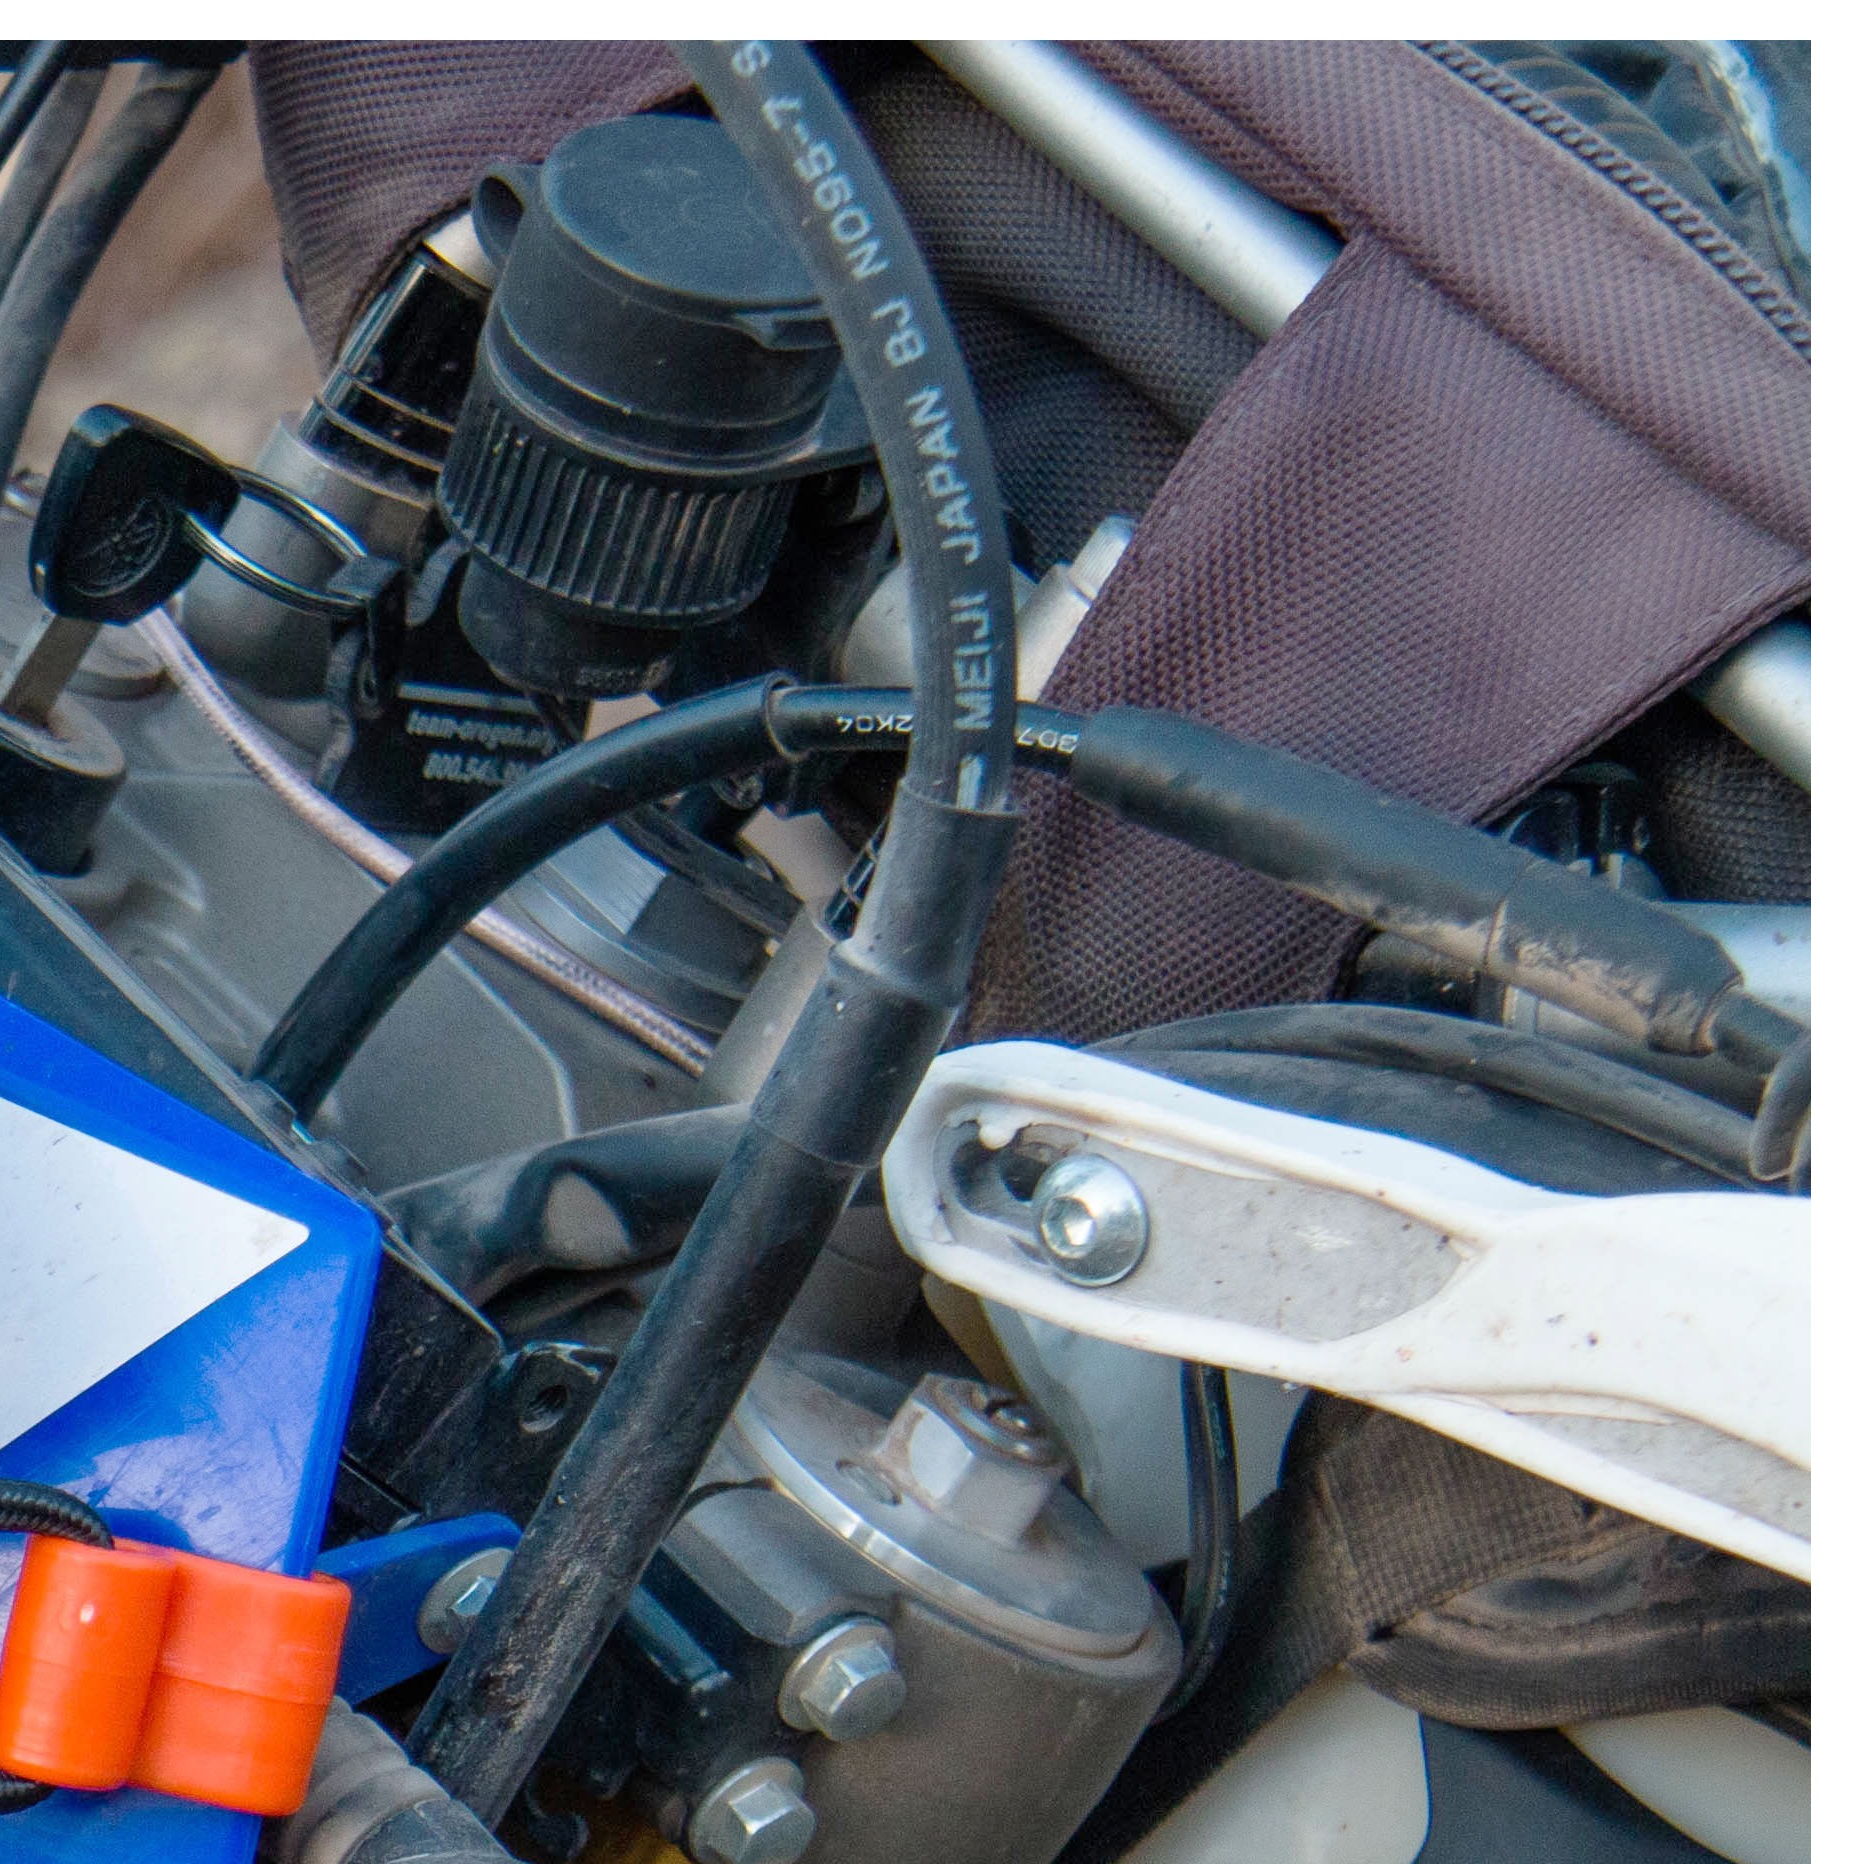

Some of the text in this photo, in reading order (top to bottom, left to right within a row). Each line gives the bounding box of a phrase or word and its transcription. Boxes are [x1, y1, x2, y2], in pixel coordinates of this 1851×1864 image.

[869, 295, 928, 369] BJ
[907, 382, 985, 566] JAPAN
[953, 589, 992, 731] MEIJI
